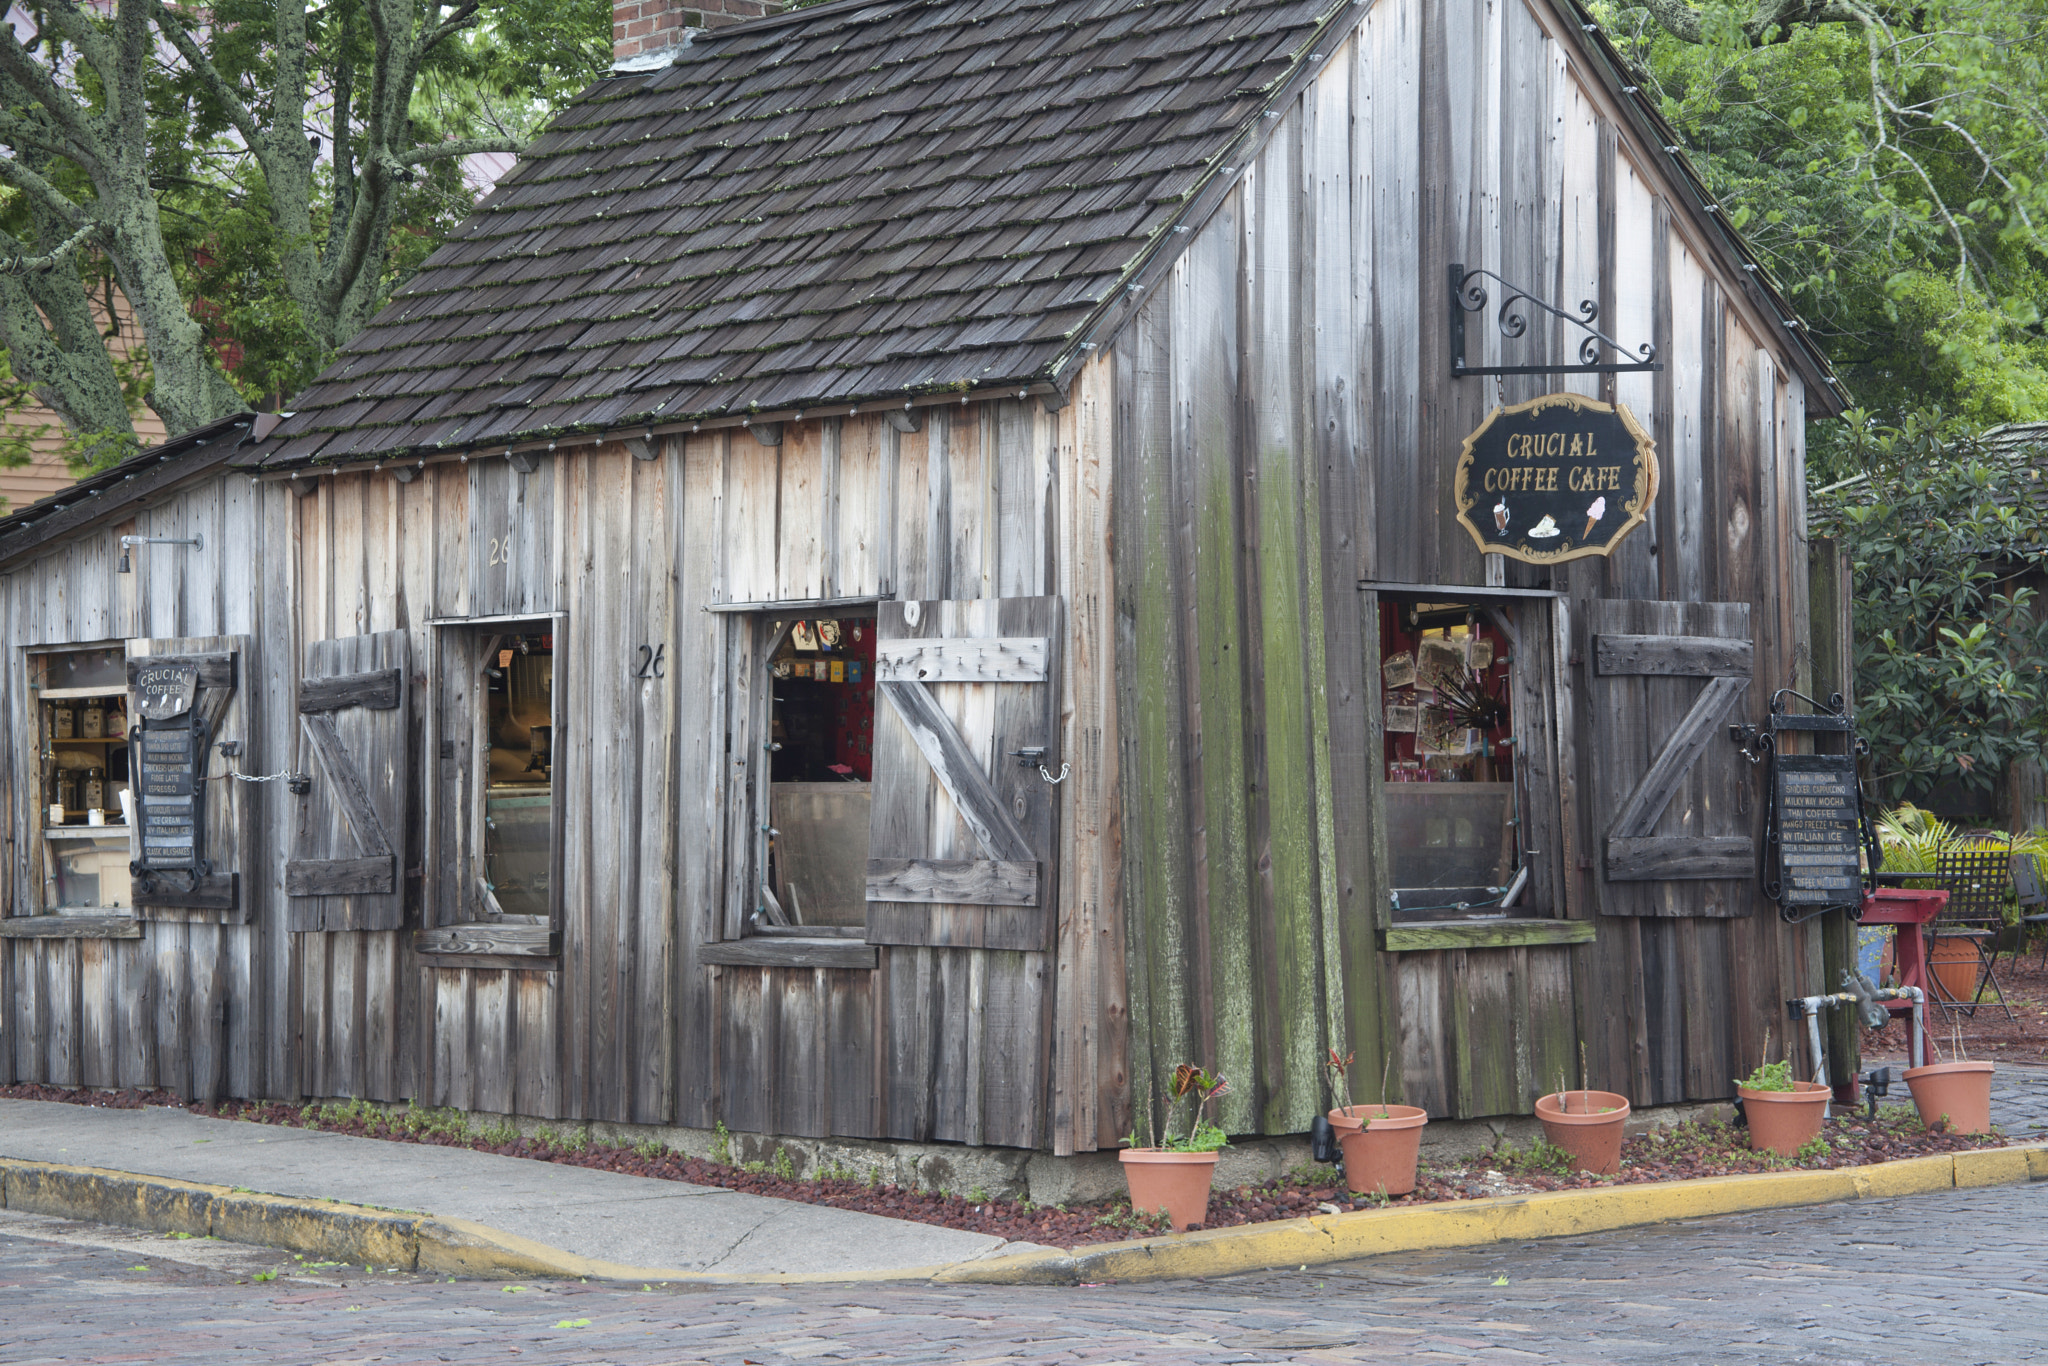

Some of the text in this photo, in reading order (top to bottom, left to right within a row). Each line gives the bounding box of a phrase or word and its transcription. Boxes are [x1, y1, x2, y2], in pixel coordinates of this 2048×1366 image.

[1507, 432, 1597, 460] CRUCIAL
[1484, 465, 1621, 492] COFFEE CAFE
[489, 535, 508, 567] 26
[637, 643, 665, 678] 26
[140, 668, 190, 687] CRUCIAL
[146, 684, 181, 695] COFFEE
[165, 774, 180, 782] LATTE
[1814, 774, 1838, 783] MOCHA
[148, 785, 177, 793] ESPRESSO
[1785, 784, 1846, 794] SNICKER CAPPUCCINO
[1784, 796, 1845, 806] MILKY WAY MOCHA
[1787, 808, 1838, 818] THAI COFFEE
[152, 816, 181, 825] ICE CREAM
[1782, 820, 1803, 829] MANGO
[1804, 820, 1828, 830] FREEZE
[146, 826, 189, 835] NY ITALIAN ICE
[1783, 831, 1842, 842] NY ITALIAN ICE
[1781, 843, 1798, 852] FROZEN
[1790, 867, 1808, 876] APPLE
[1821, 867, 1843, 876] CIDER
[1793, 877, 1848, 888] TOFFEE NUT LATTE
[1788, 889, 1828, 901] PASTRIES
